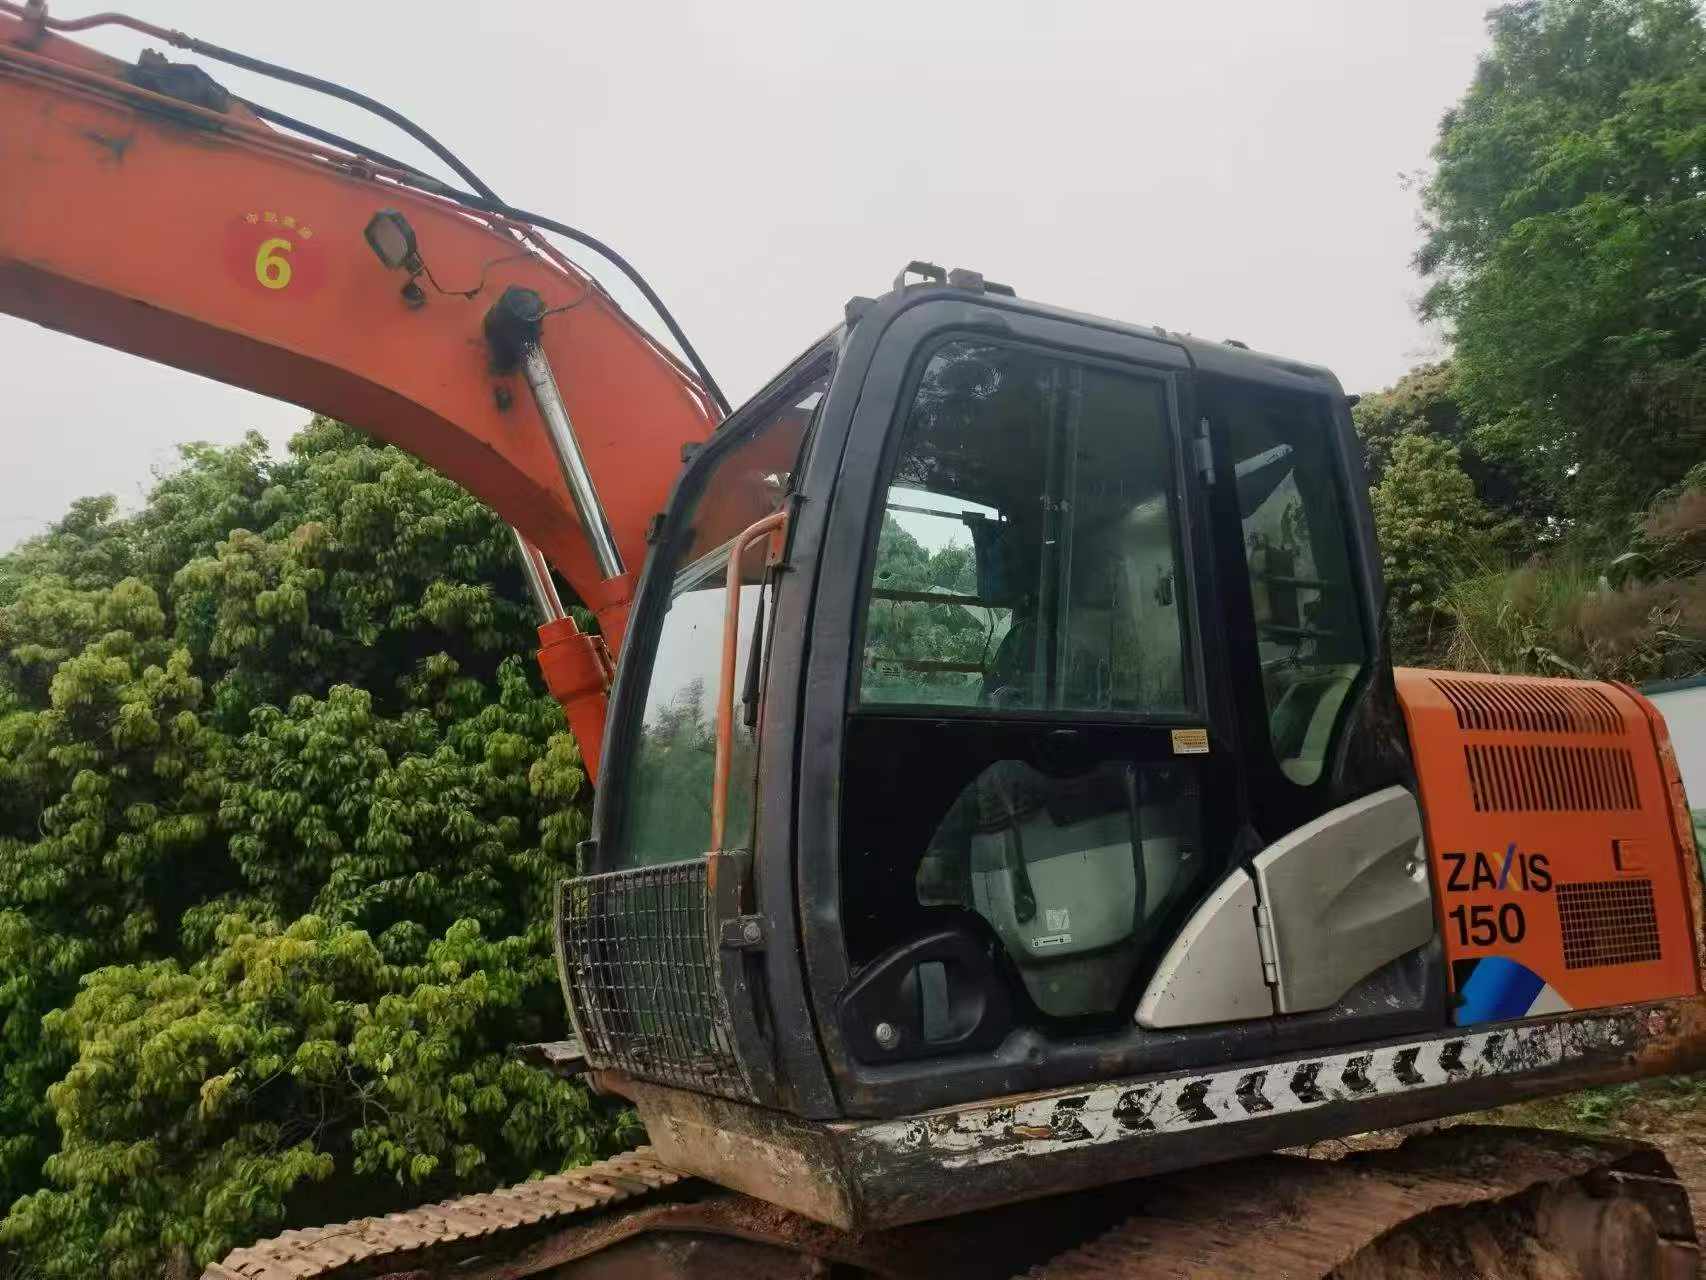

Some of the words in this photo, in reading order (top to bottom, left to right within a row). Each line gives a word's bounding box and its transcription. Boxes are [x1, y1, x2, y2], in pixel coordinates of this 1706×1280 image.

[255, 237, 292, 289] 6
[1442, 841, 1552, 892] ZAXIS
[1449, 902, 1526, 946] 150
